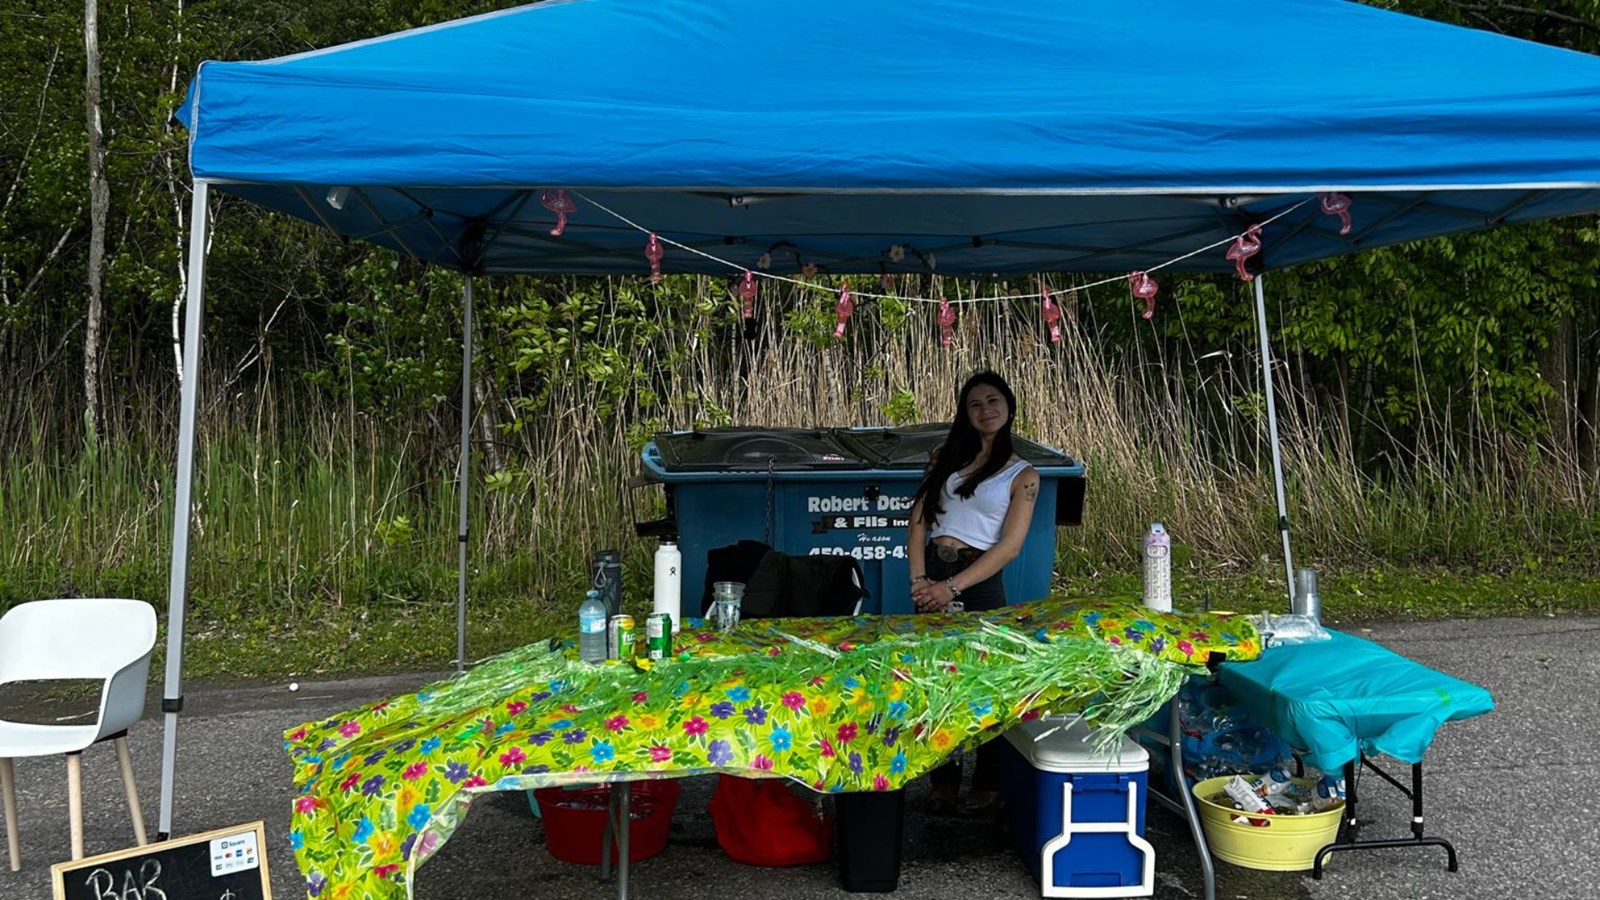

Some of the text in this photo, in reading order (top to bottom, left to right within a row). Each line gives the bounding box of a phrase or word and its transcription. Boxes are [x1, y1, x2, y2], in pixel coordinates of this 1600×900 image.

[808, 495, 915, 512] Robert Dao
[834, 517, 848, 528] &
[854, 516, 888, 527] Fils
[809, 546, 907, 559] 450-458-4
[85, 858, 168, 900] BAR
